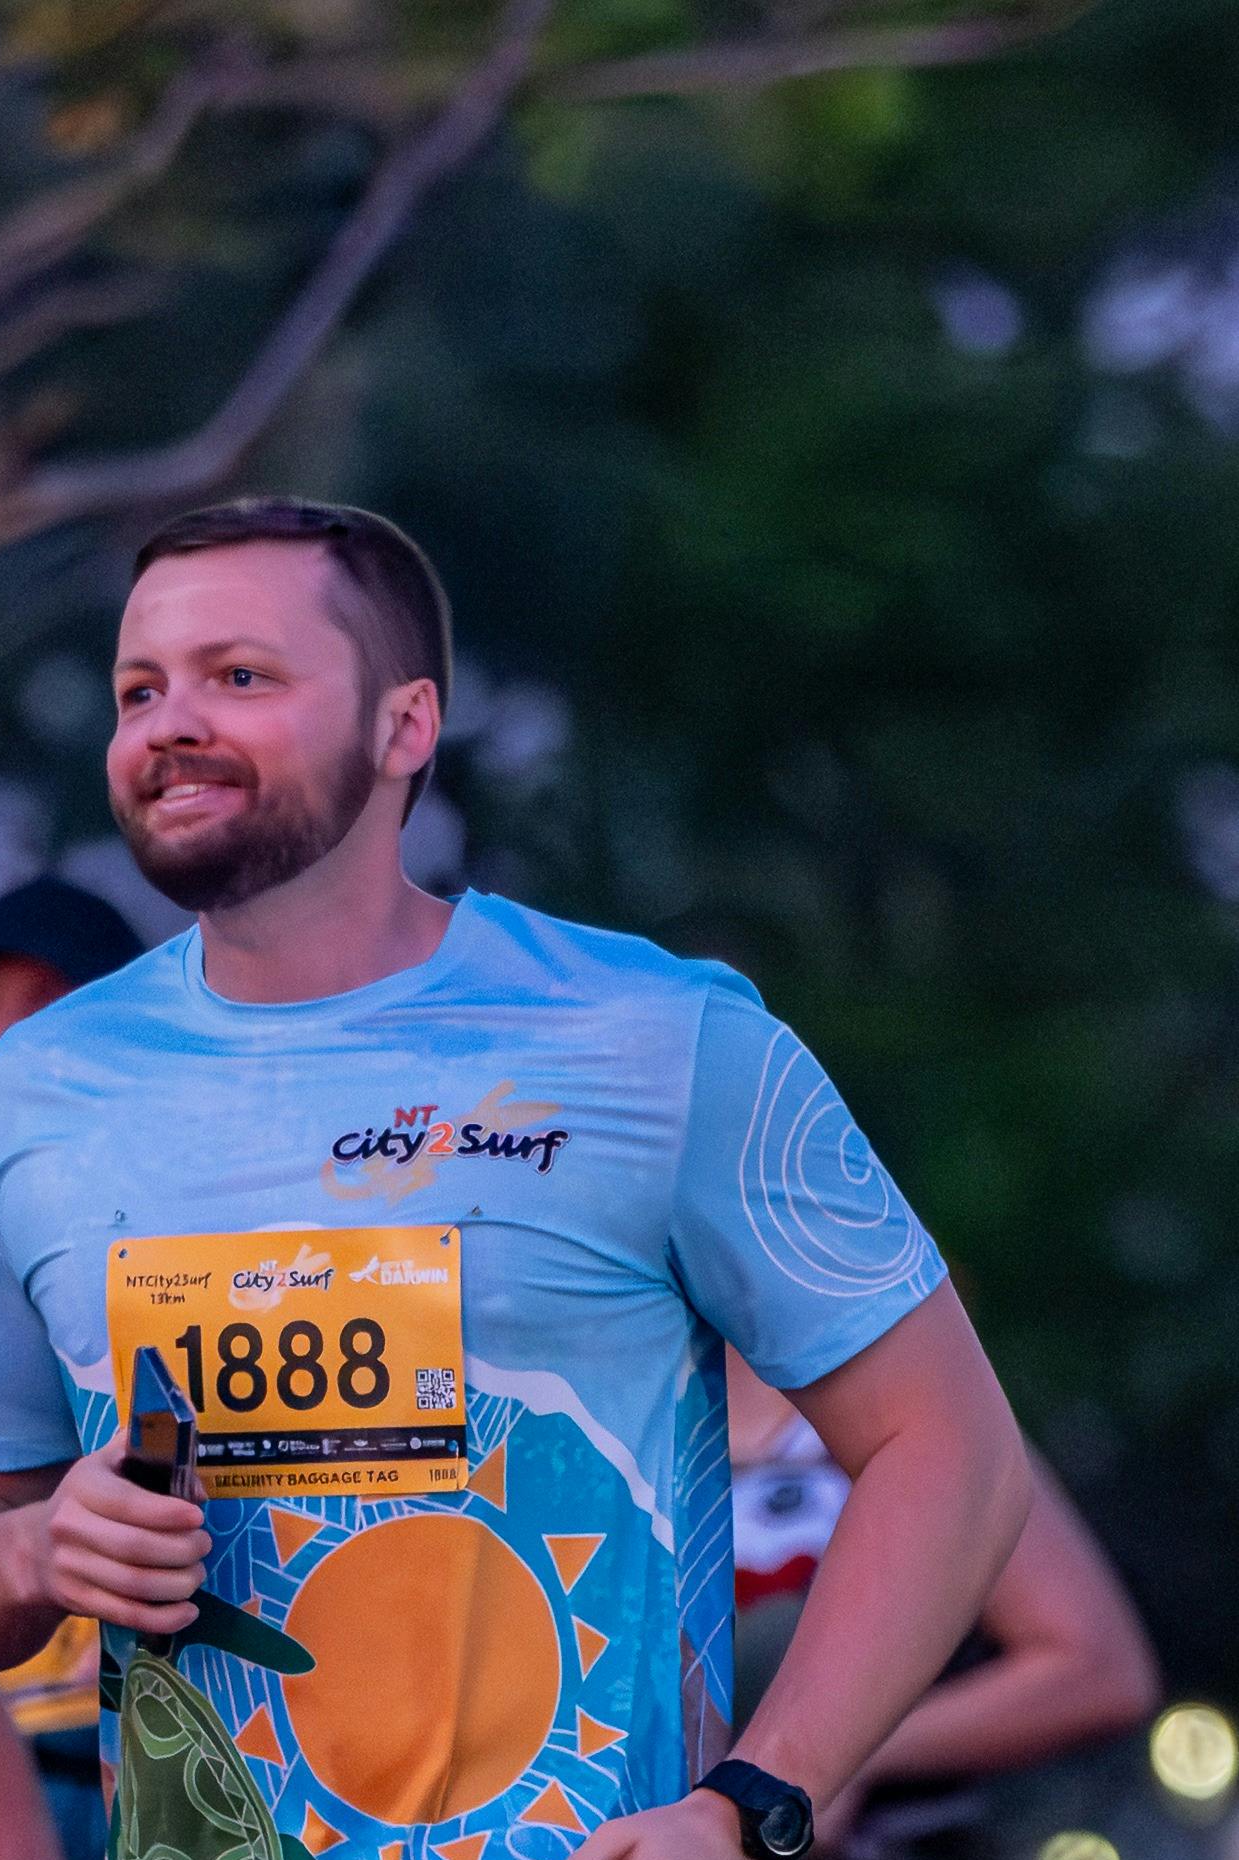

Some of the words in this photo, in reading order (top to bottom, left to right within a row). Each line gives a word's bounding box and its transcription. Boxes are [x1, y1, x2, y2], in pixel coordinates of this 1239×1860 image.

[393, 1104, 439, 1128] NT
[174, 1317, 390, 1413] 1888
[214, 1474, 282, 1489] SECURITY
[288, 1471, 361, 1486] BAGGAGE
[367, 1470, 399, 1484] TAG
